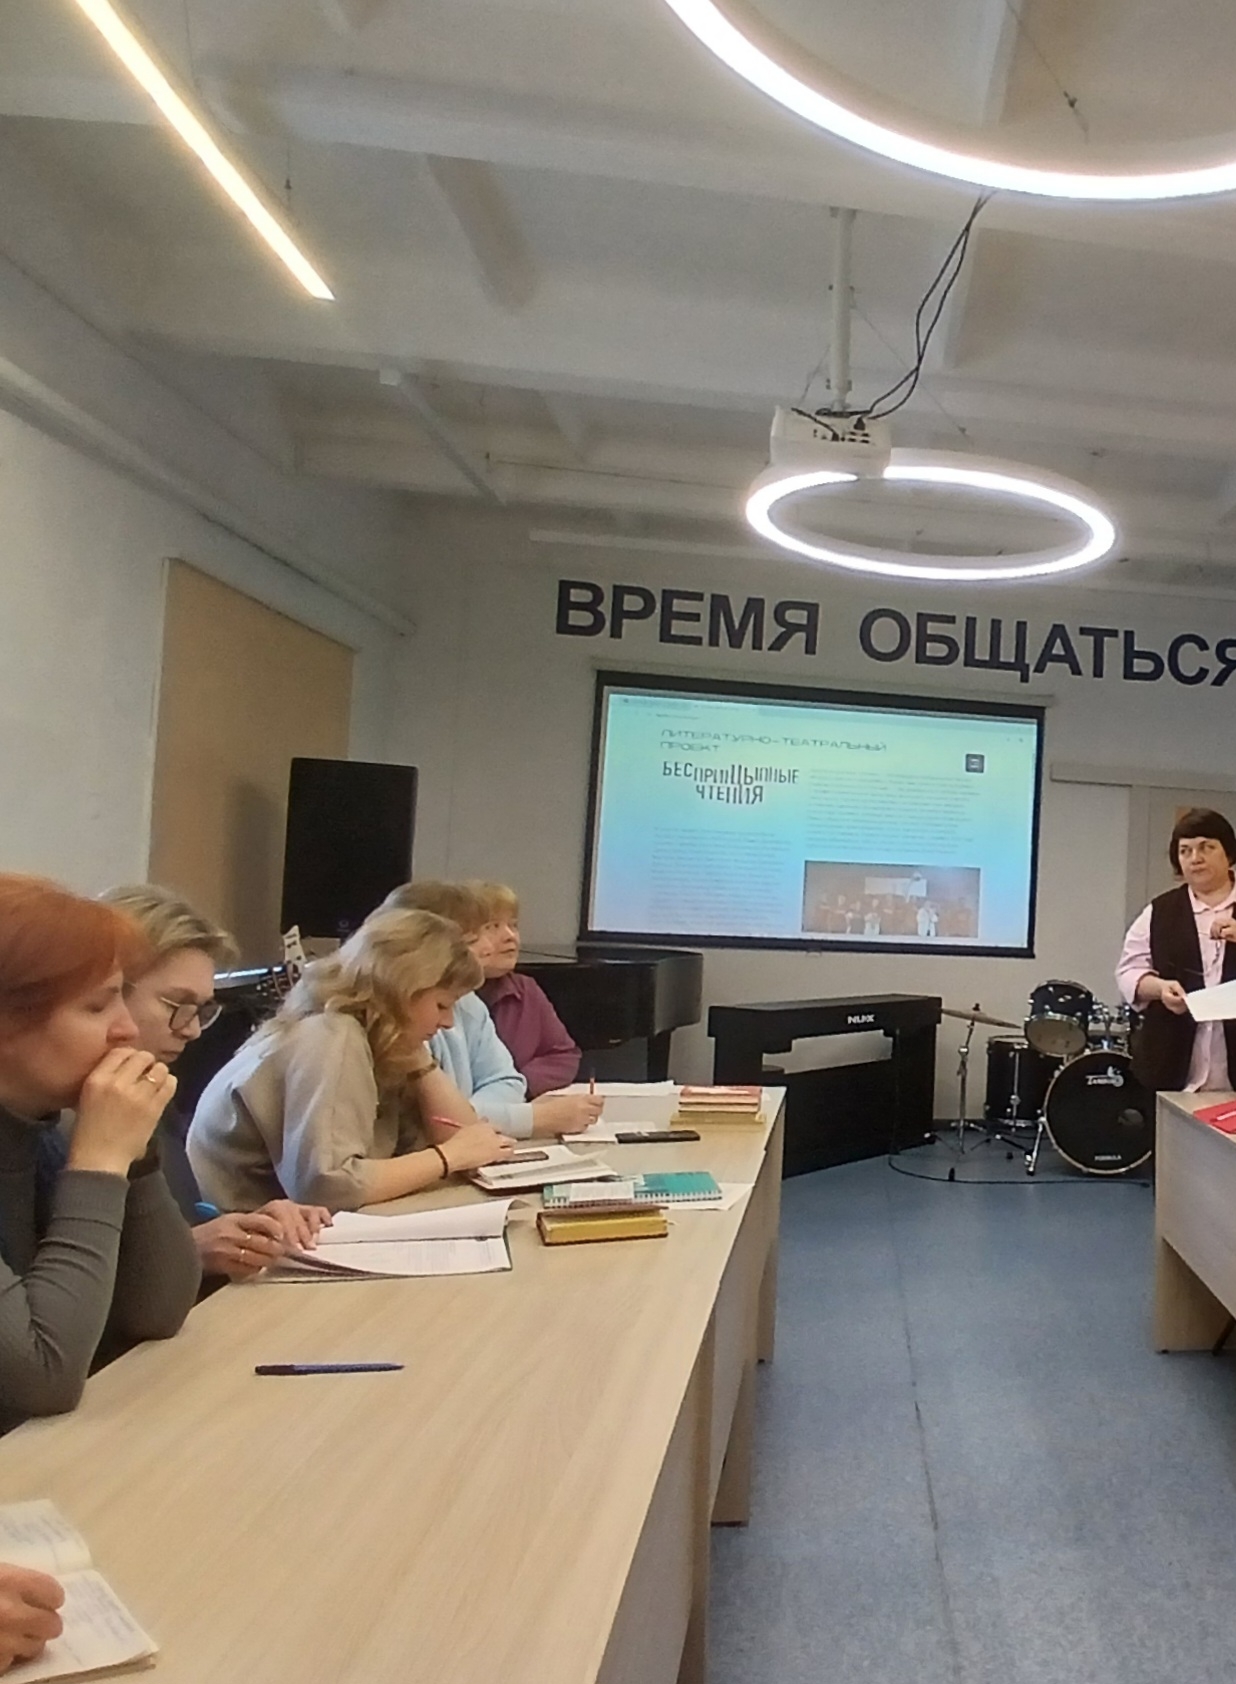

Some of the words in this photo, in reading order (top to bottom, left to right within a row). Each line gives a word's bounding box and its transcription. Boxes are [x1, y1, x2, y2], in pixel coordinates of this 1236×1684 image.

[555, 579, 820, 656] ВРЕМЯ
[660, 741, 721, 752] ПРОЕКТ
[695, 784, 764, 805] ЧТЕНИЯ
